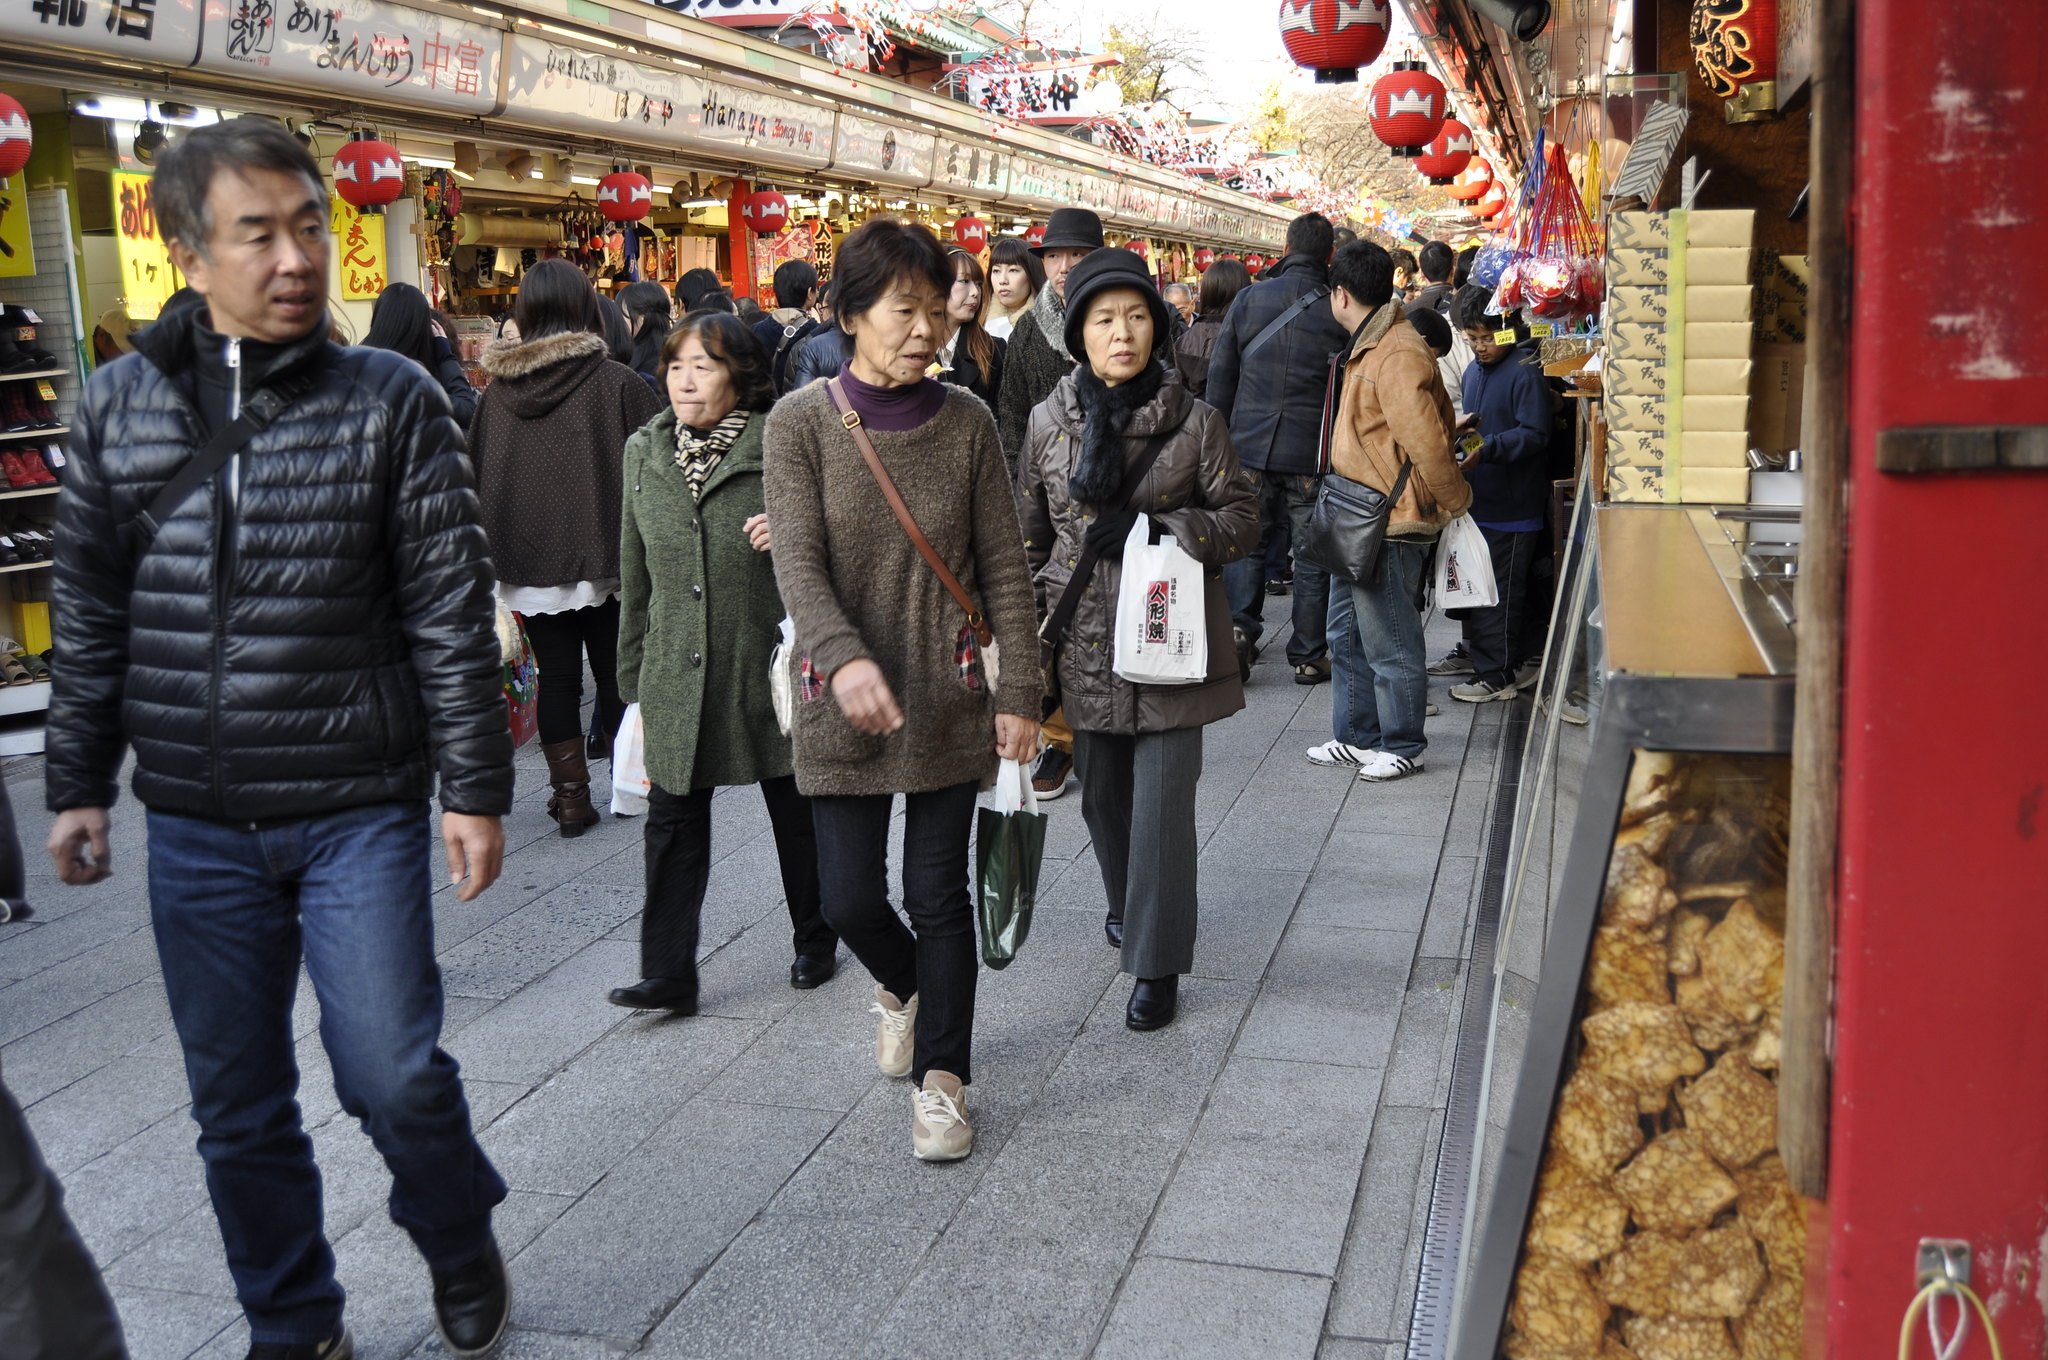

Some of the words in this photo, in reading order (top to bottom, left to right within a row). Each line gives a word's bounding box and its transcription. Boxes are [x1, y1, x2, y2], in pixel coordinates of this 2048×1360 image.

[422, 31, 485, 97] 中富
[703, 88, 767, 147] Hanaya
[814, 222, 833, 282] 人形焼
[1147, 584, 1166, 640] 人形焼
